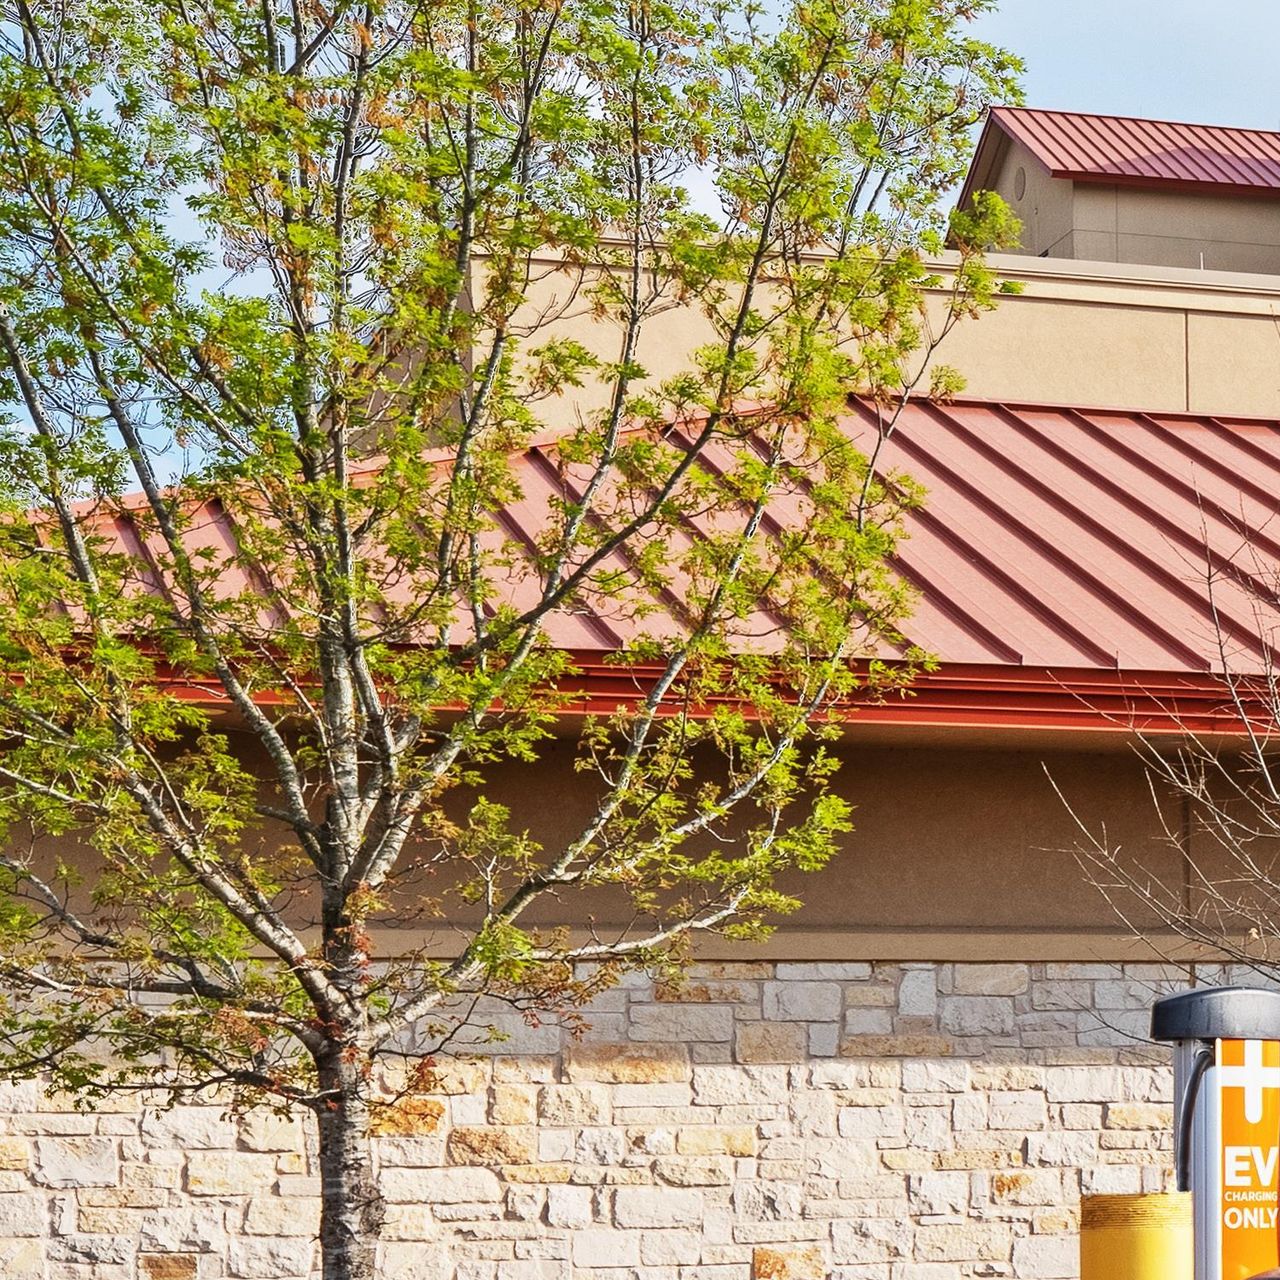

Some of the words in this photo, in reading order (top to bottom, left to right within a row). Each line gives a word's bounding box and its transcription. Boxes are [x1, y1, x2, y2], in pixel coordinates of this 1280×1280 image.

[1224, 1145, 1279, 1187] EV
[1224, 1190, 1278, 1202] CHARGING
[1223, 1206, 1279, 1230] ONLY
